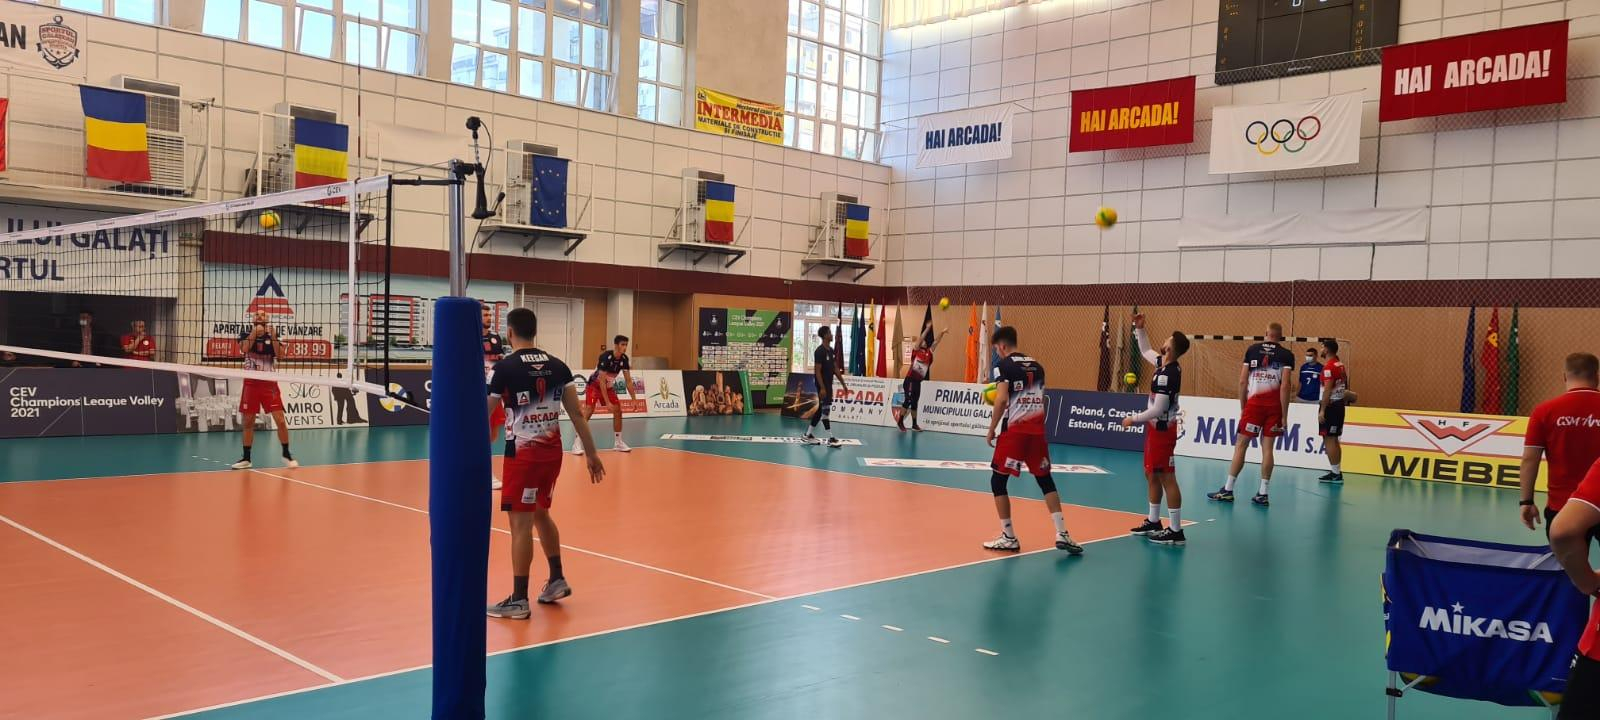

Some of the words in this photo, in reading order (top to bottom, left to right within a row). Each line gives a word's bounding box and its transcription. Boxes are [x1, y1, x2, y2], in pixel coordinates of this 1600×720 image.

[1394, 69, 1432, 95] HAI
[1443, 49, 1551, 89] ARCADA!
[697, 100, 782, 132] INTERMEDIA
[698, 116, 732, 129] MATERIALE
[1080, 110, 1106, 133] HAI
[1108, 101, 1179, 131] ARCADA!
[731, 128, 757, 139] FINISAJE
[925, 129, 946, 150] HAI
[948, 122, 1002, 147] ARCADA!
[213, 323, 252, 335] APARTAM
[520, 353, 549, 362] KEEGAN
[10, 387, 37, 397] CEV
[834, 388, 884, 406] RCADA
[935, 388, 985, 406] PRIMĂRI
[10, 396, 80, 408] Champions
[83, 396, 127, 408] League
[129, 396, 164, 407] Volley
[283, 402, 323, 414] AMIRO
[654, 400, 679, 409] Arcada
[11, 408, 39, 418] 2021
[832, 405, 883, 415] OMPANY
[923, 404, 972, 417] MUNICIPIULUI
[973, 411, 992, 419] GALA
[1070, 405, 1106, 418] Poland,
[1108, 408, 1142, 418] Czechi
[286, 415, 324, 426] VENTS
[522, 411, 559, 424] ARCADA
[1068, 418, 1104, 432] Estonia,
[1194, 416, 1301, 452] NAVM
